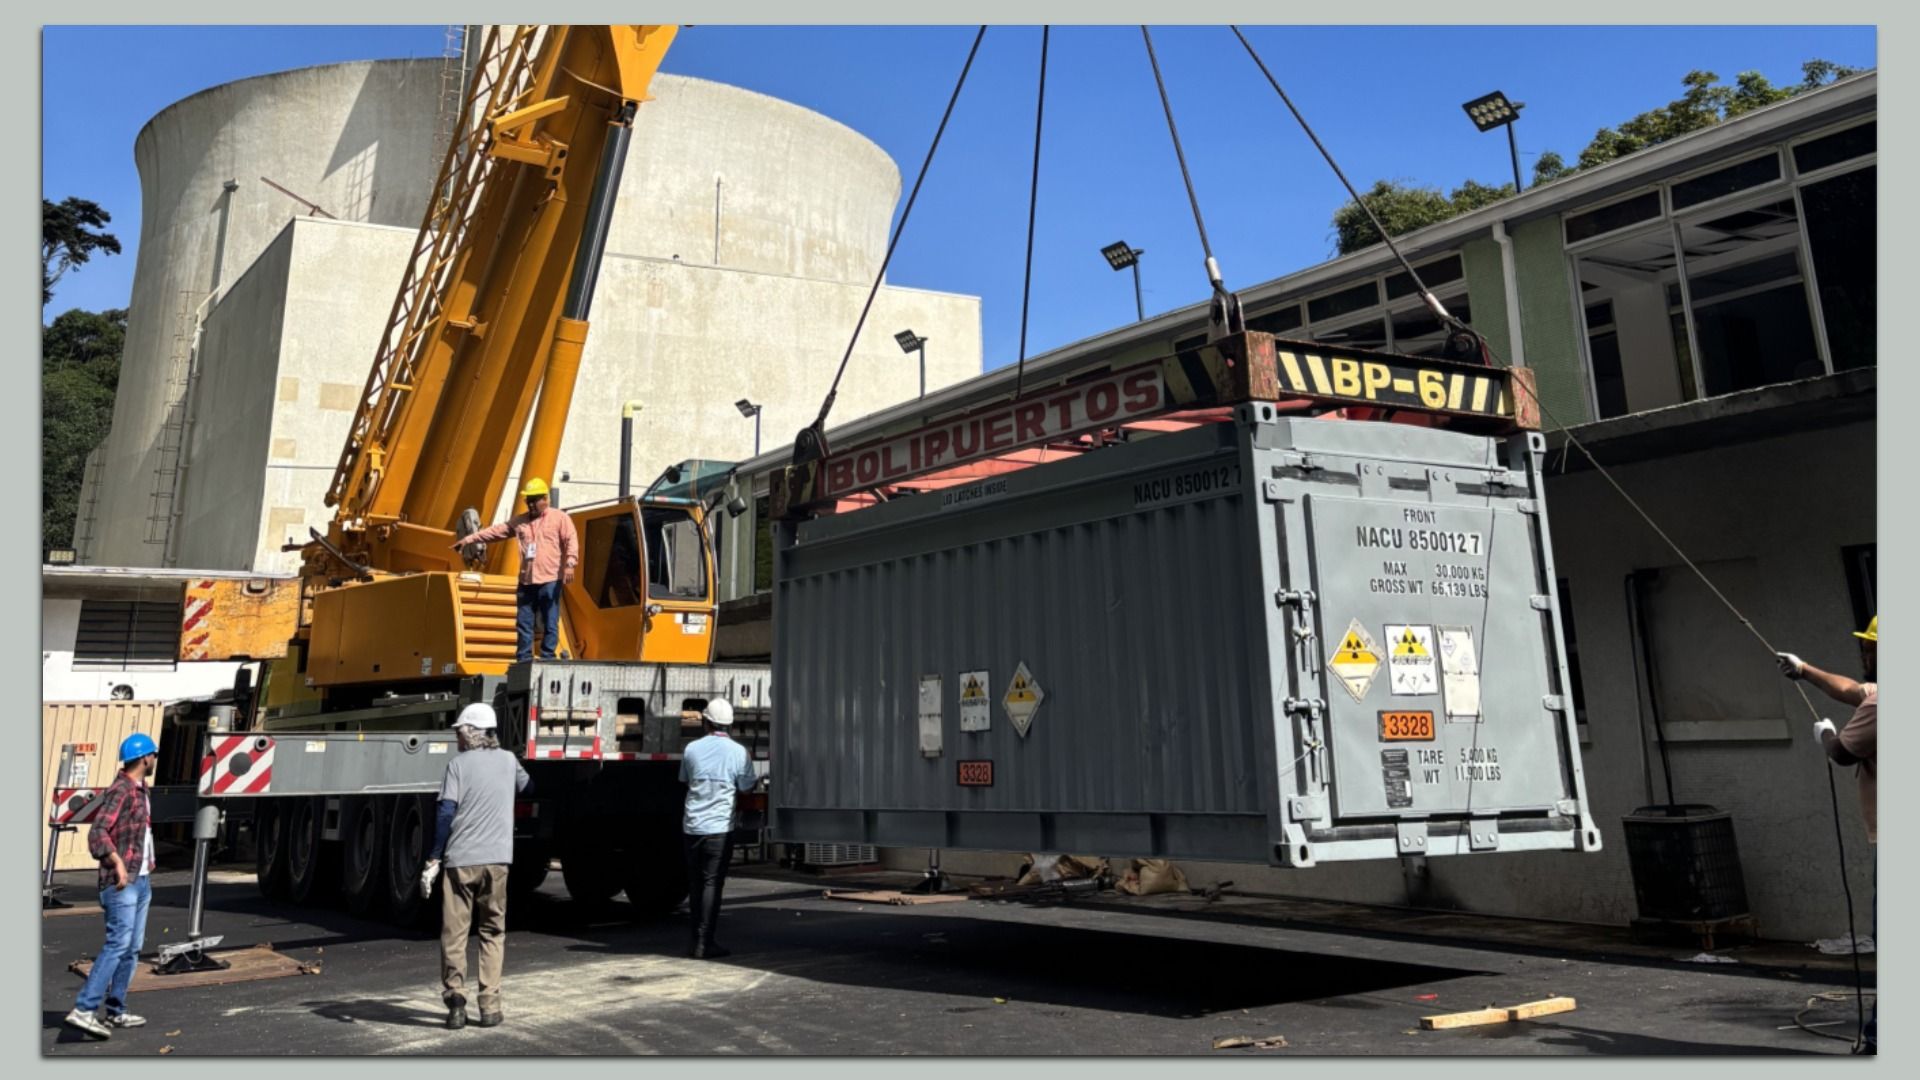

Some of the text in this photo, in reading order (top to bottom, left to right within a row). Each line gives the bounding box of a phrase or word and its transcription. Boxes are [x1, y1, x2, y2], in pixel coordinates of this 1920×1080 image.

[1332, 357, 1446, 409] BP-6
[828, 369, 1160, 492] BOLIPUERTOS
[1134, 478, 1170, 504] NACU
[1403, 508, 1436, 524] FRONT
[1356, 526, 1403, 549] NACU
[1383, 561, 1407, 576] MAX
[1471, 566, 1485, 581] KG
[1370, 579, 1405, 594] GROSS
[1407, 580, 1424, 594] WT
[1468, 583, 1487, 599] LBS
[1389, 715, 1430, 736] 3328
[1417, 750, 1444, 765] TARE
[1486, 748, 1499, 763] KG
[963, 764, 989, 782] 3328
[1424, 769, 1440, 784] WT
[1486, 766, 1502, 781] LBS
